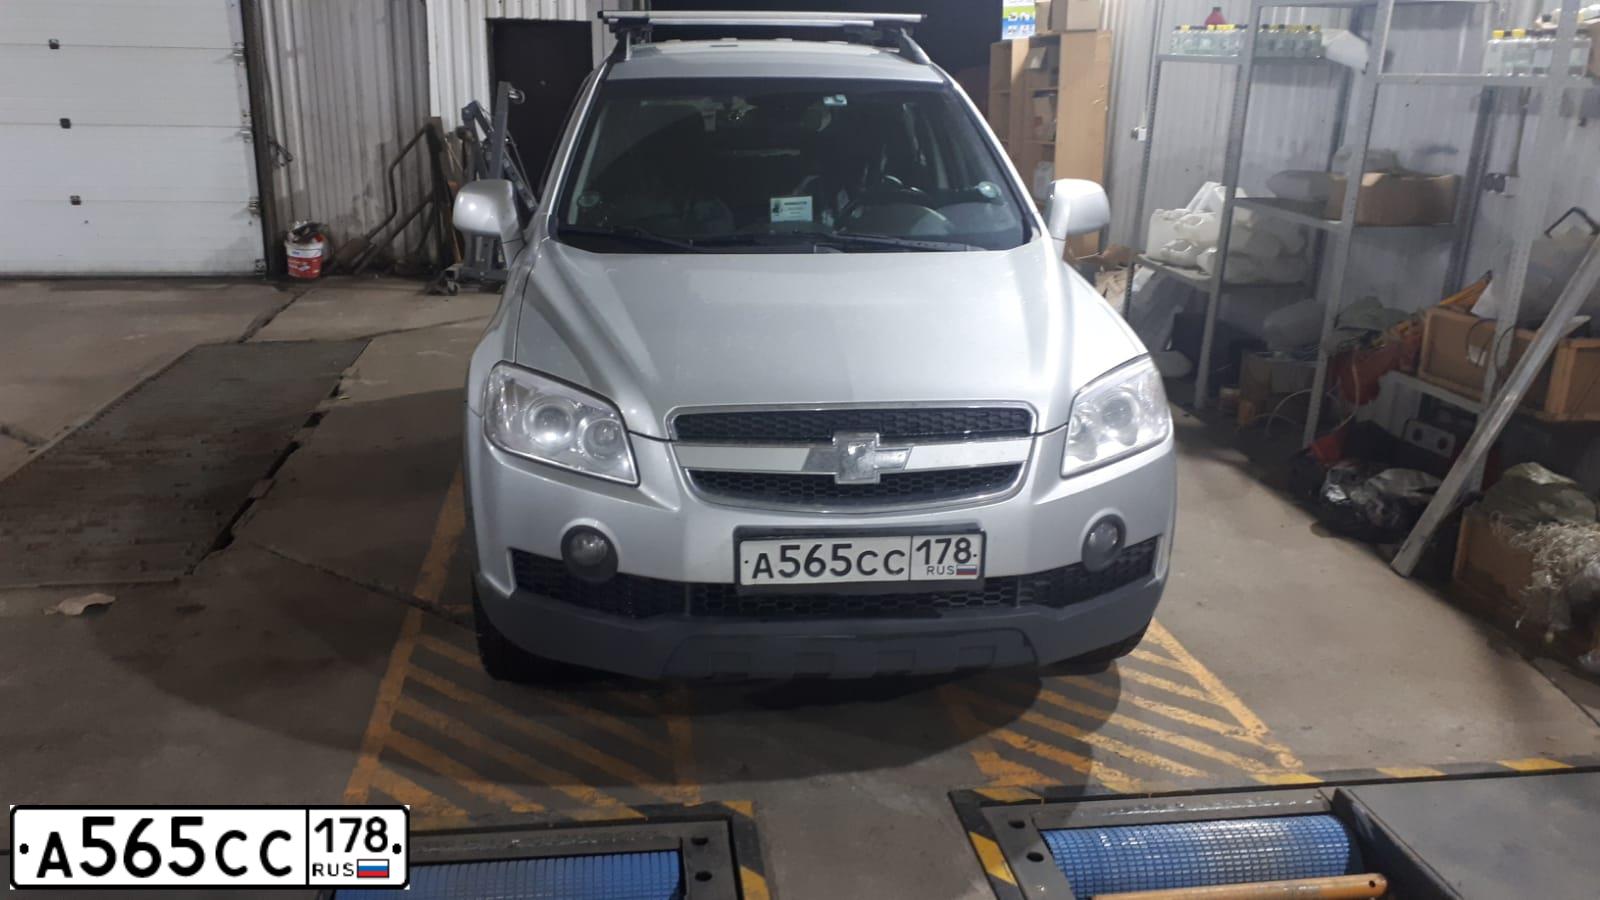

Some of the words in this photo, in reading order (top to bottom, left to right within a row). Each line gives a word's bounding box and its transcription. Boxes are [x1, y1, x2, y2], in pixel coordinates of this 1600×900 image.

[751, 543, 906, 579] A565CC
[915, 537, 972, 566] 178
[926, 565, 955, 576] RUS
